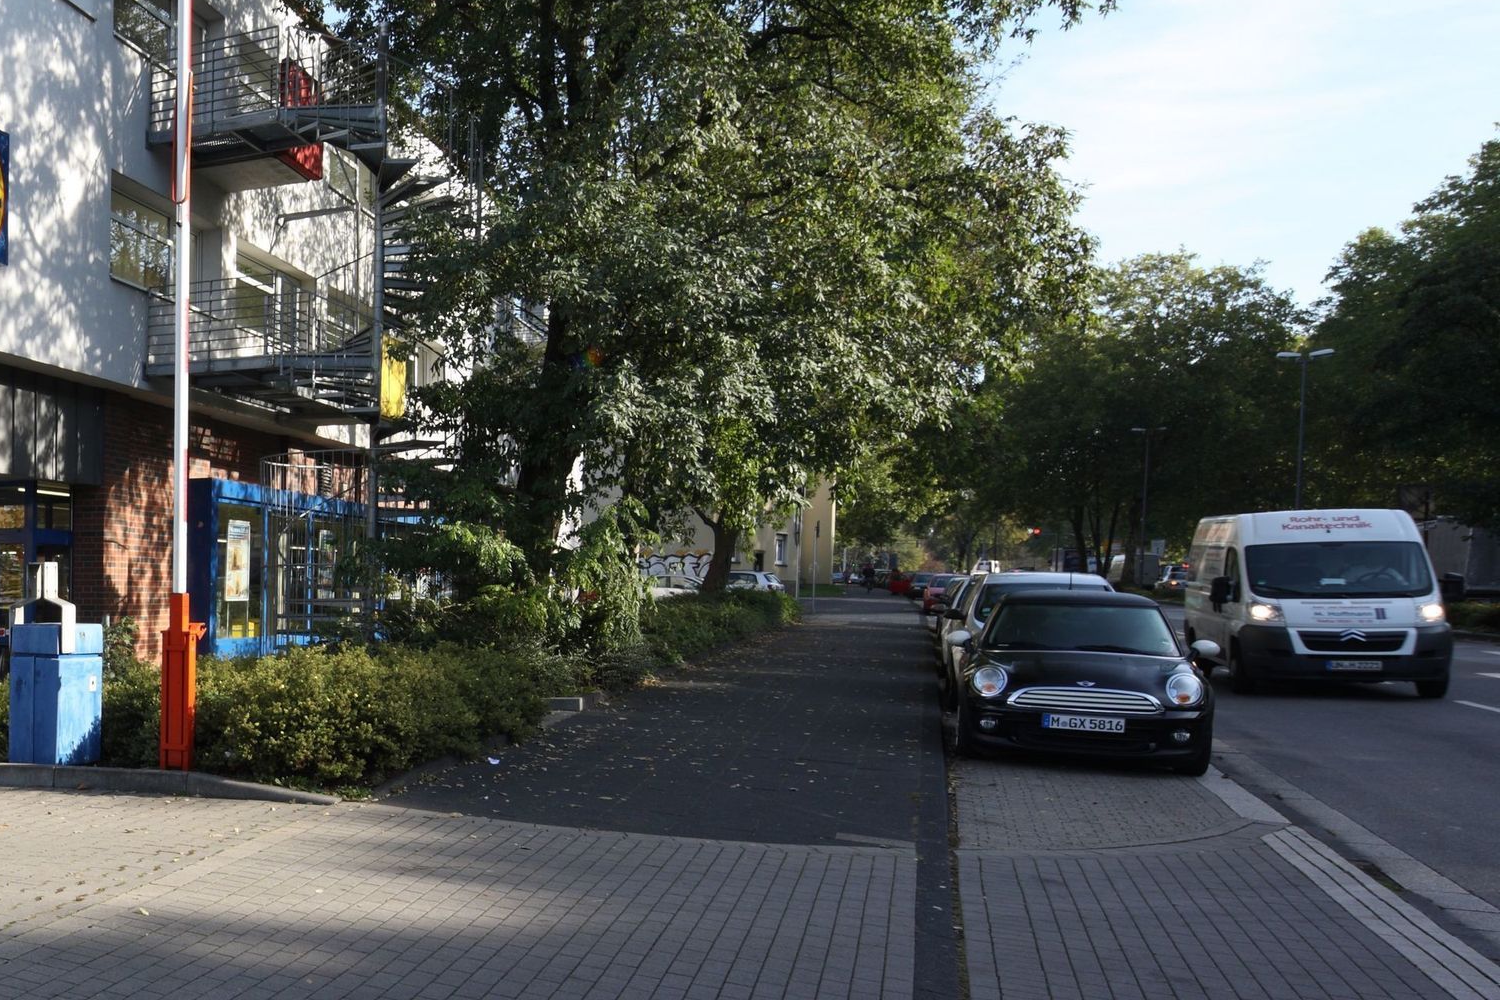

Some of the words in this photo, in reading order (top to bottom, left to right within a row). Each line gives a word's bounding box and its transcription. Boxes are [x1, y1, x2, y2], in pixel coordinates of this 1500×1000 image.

[1282, 522, 1373, 530] Kanaltechnik
[1051, 716, 1060, 727] M
[1068, 717, 1086, 729] GX
[1089, 719, 1123, 731] 5816
